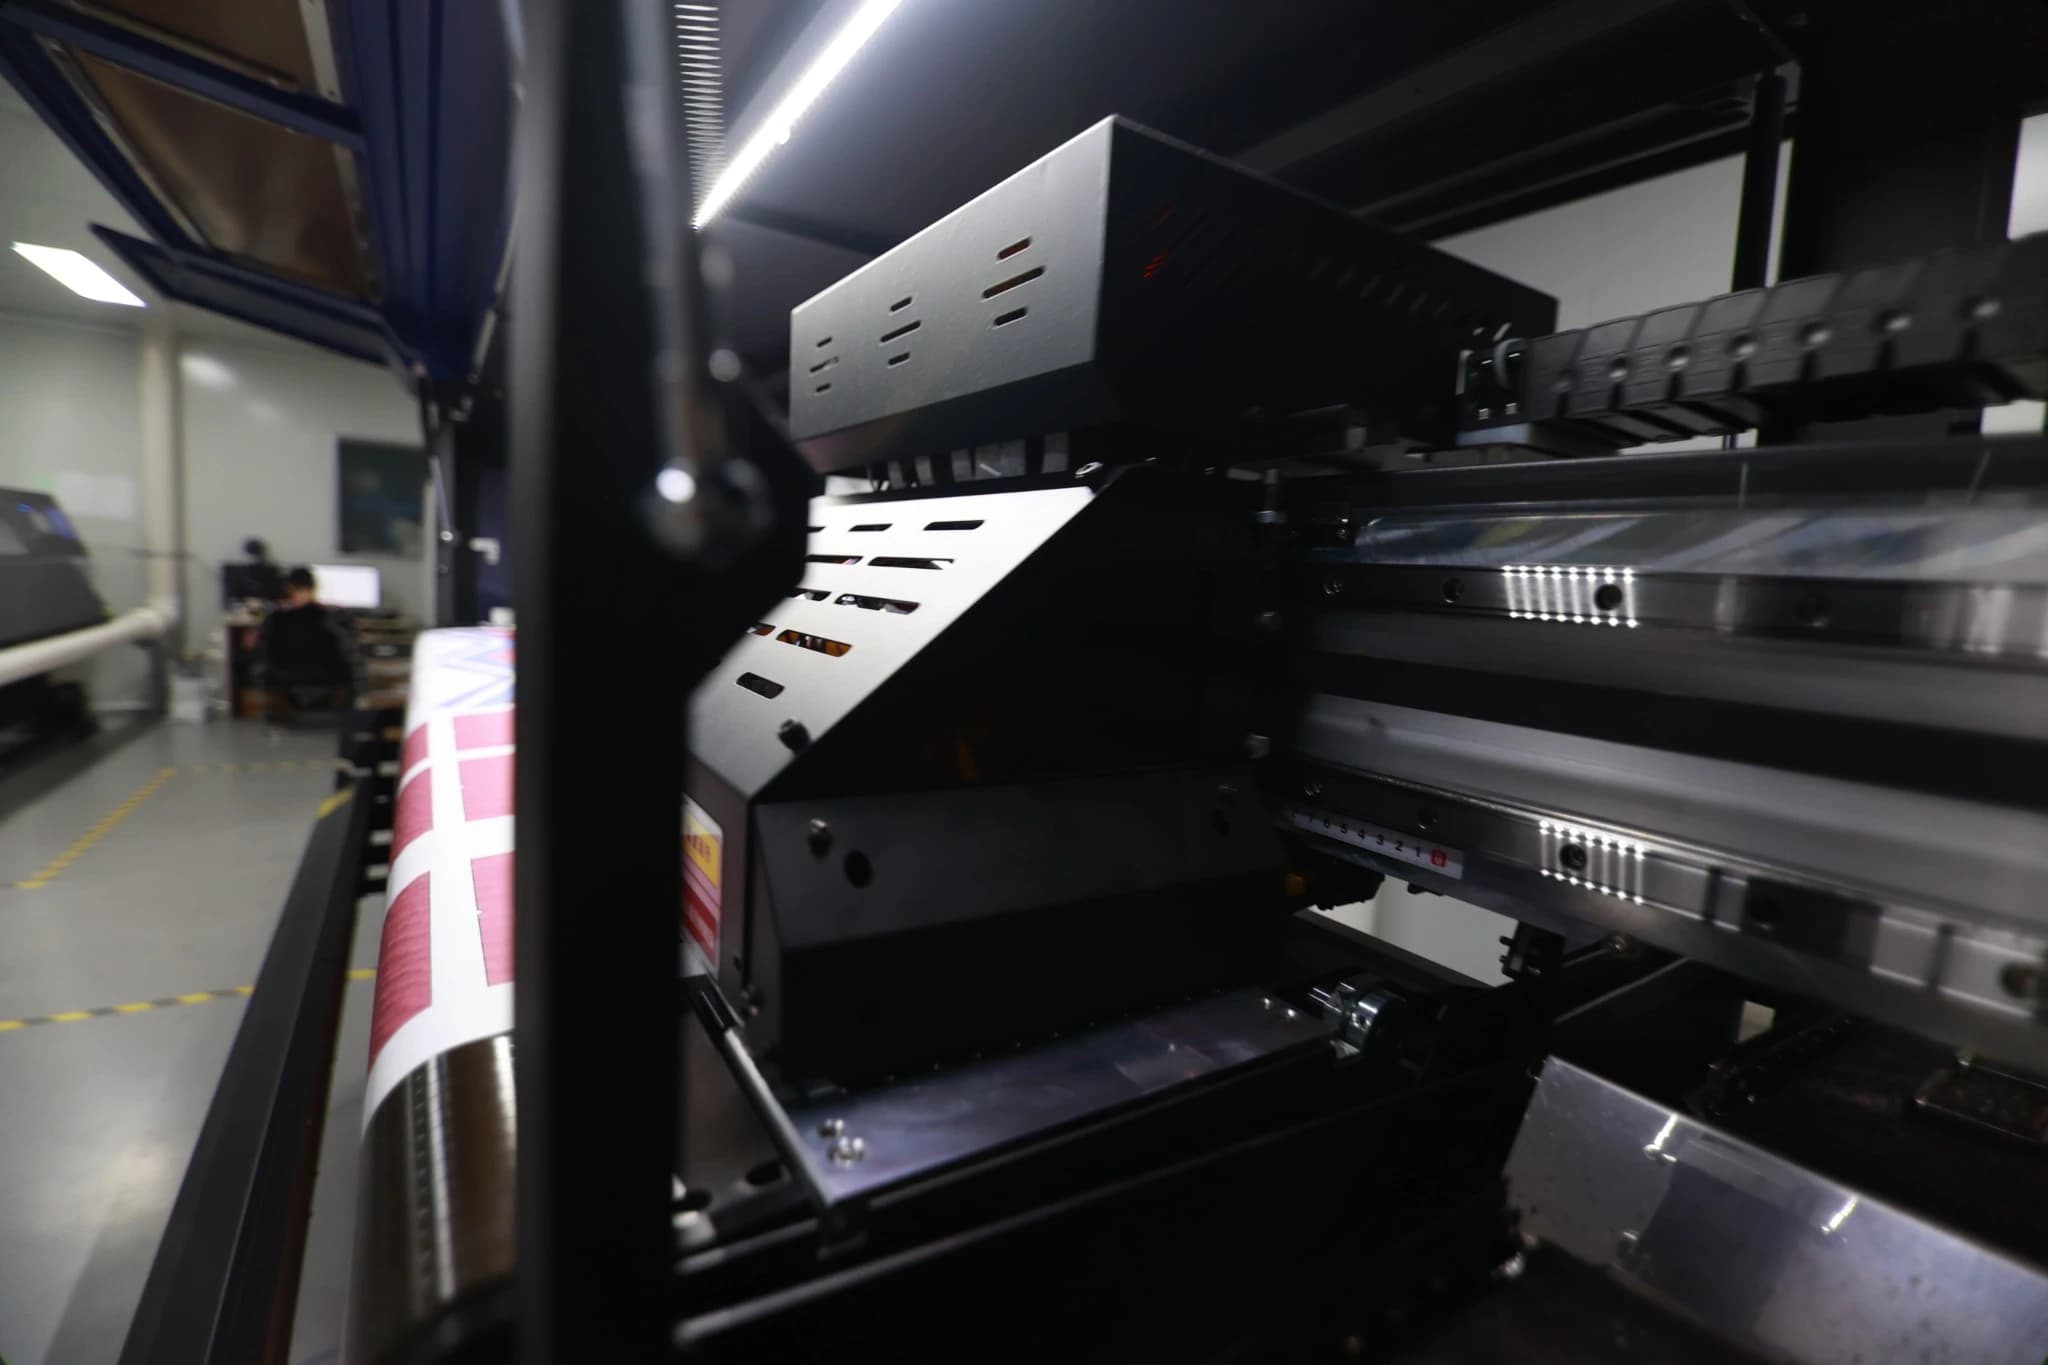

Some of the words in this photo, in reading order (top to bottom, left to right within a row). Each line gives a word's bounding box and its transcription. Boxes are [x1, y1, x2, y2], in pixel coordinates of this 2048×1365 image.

[1340, 823, 1348, 834] 5
[1357, 829, 1365, 840] 4
[1376, 834, 1384, 846] 3
[1395, 840, 1403, 852] 2
[1415, 847, 1421, 857] 1
